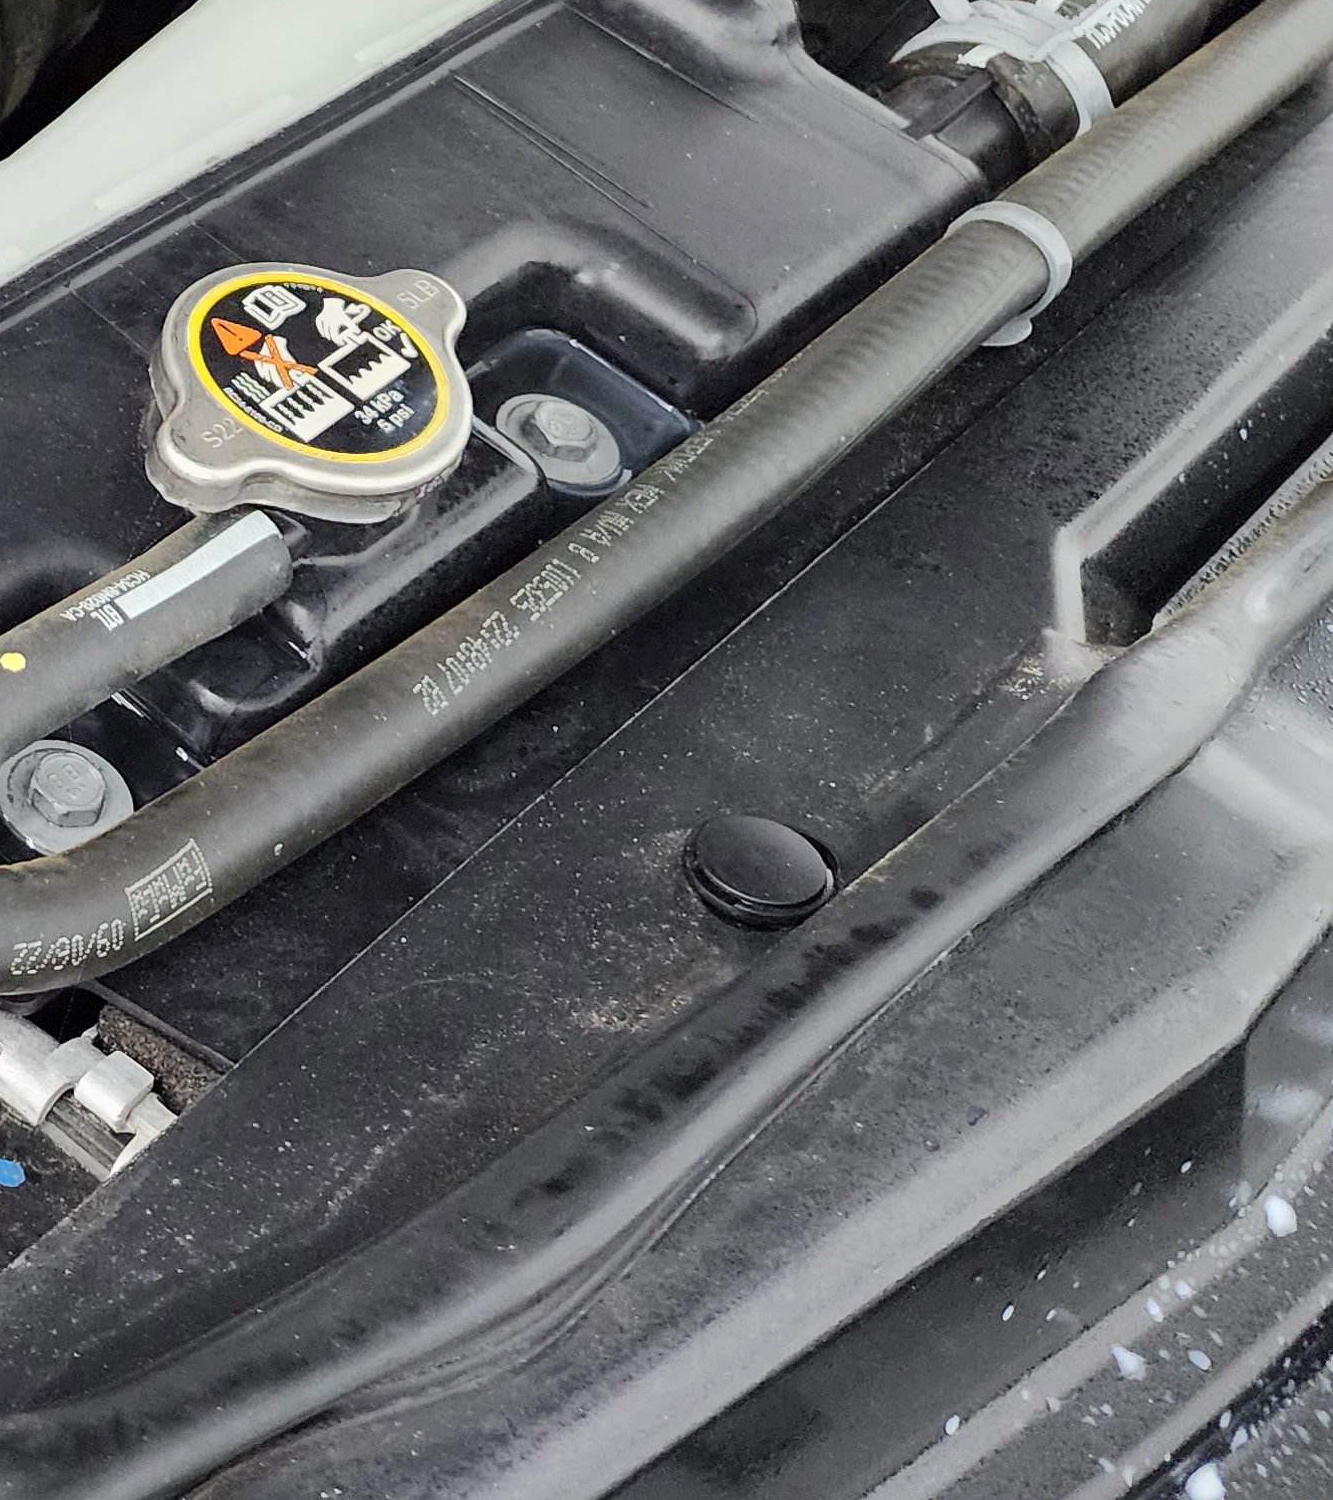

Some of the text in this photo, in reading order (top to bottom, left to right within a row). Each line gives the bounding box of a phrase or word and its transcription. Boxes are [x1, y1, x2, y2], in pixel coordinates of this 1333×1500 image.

[372, 319, 401, 342] OK
[354, 388, 405, 426] 34 kPa
[387, 405, 416, 431] psi
